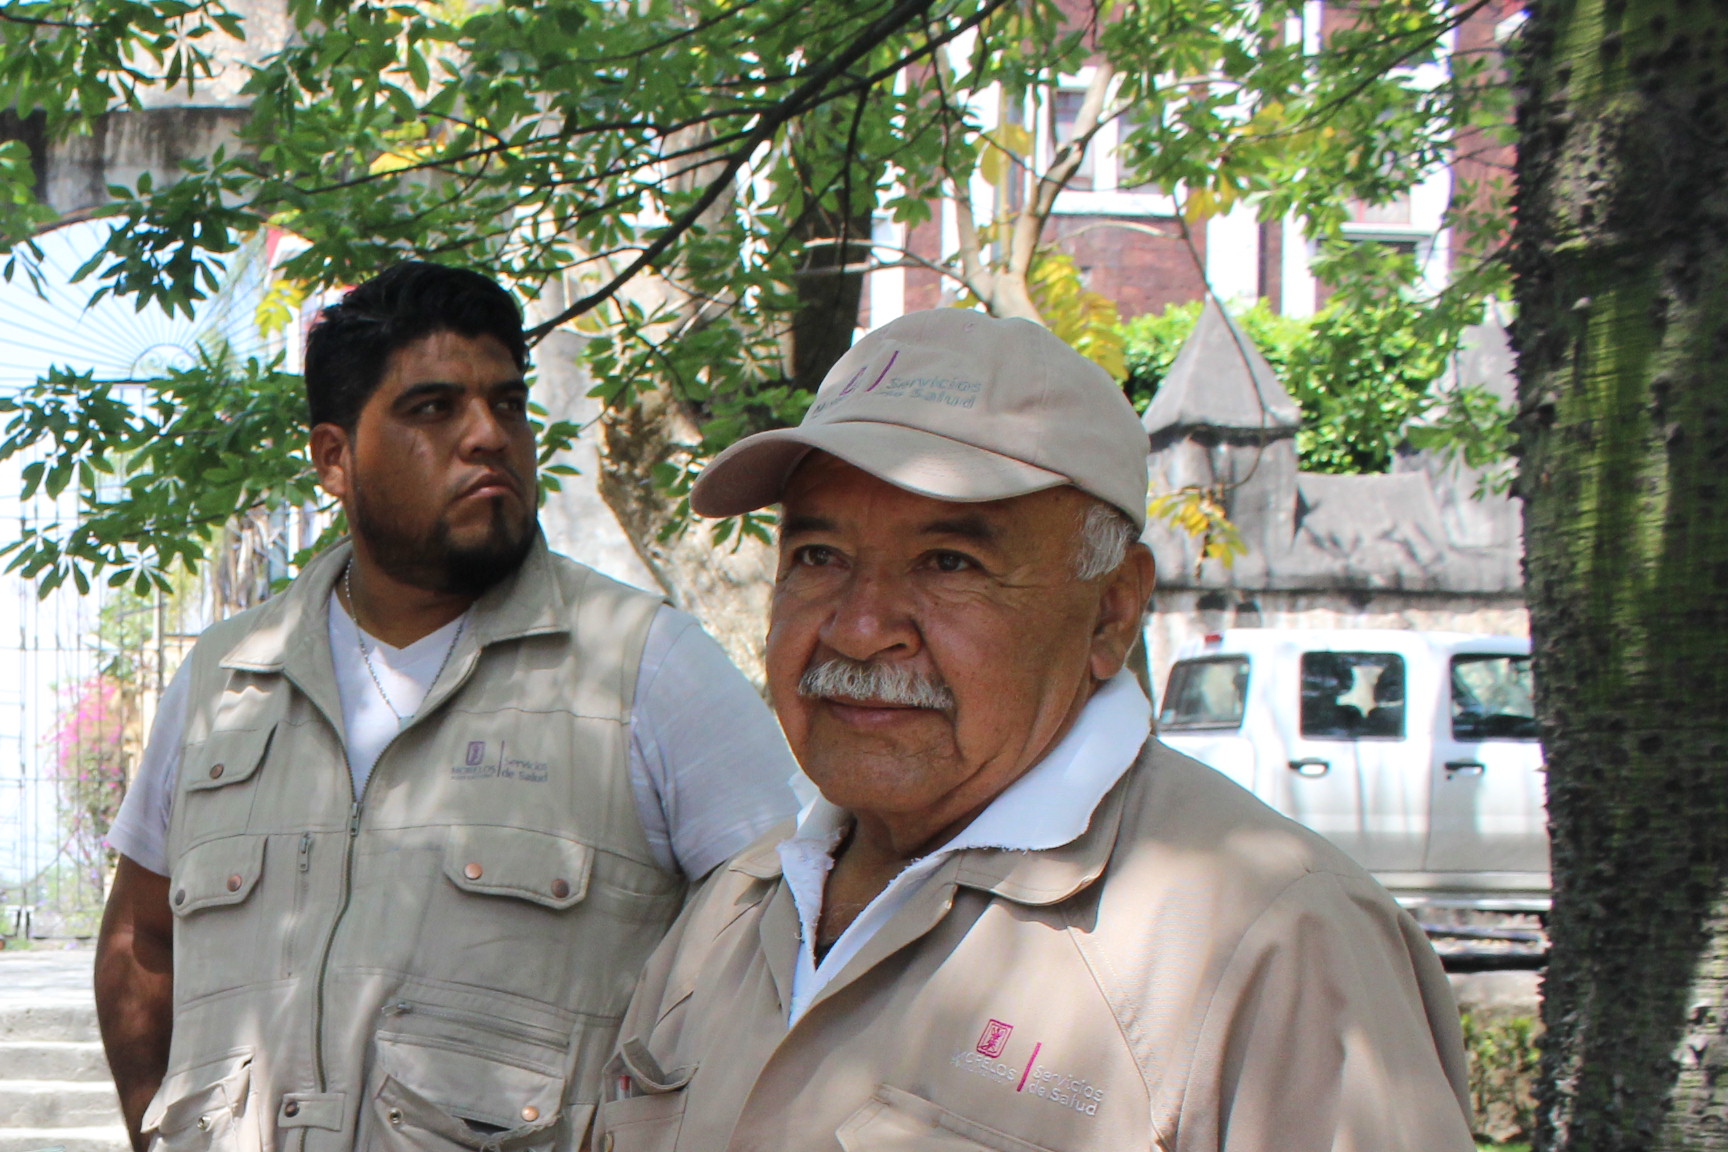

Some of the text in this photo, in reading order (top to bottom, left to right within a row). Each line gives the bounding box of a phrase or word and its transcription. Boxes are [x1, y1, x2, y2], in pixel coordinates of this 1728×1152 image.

[1027, 1080, 1098, 1116] de Salud
[1032, 1064, 1104, 1102] Servicios
